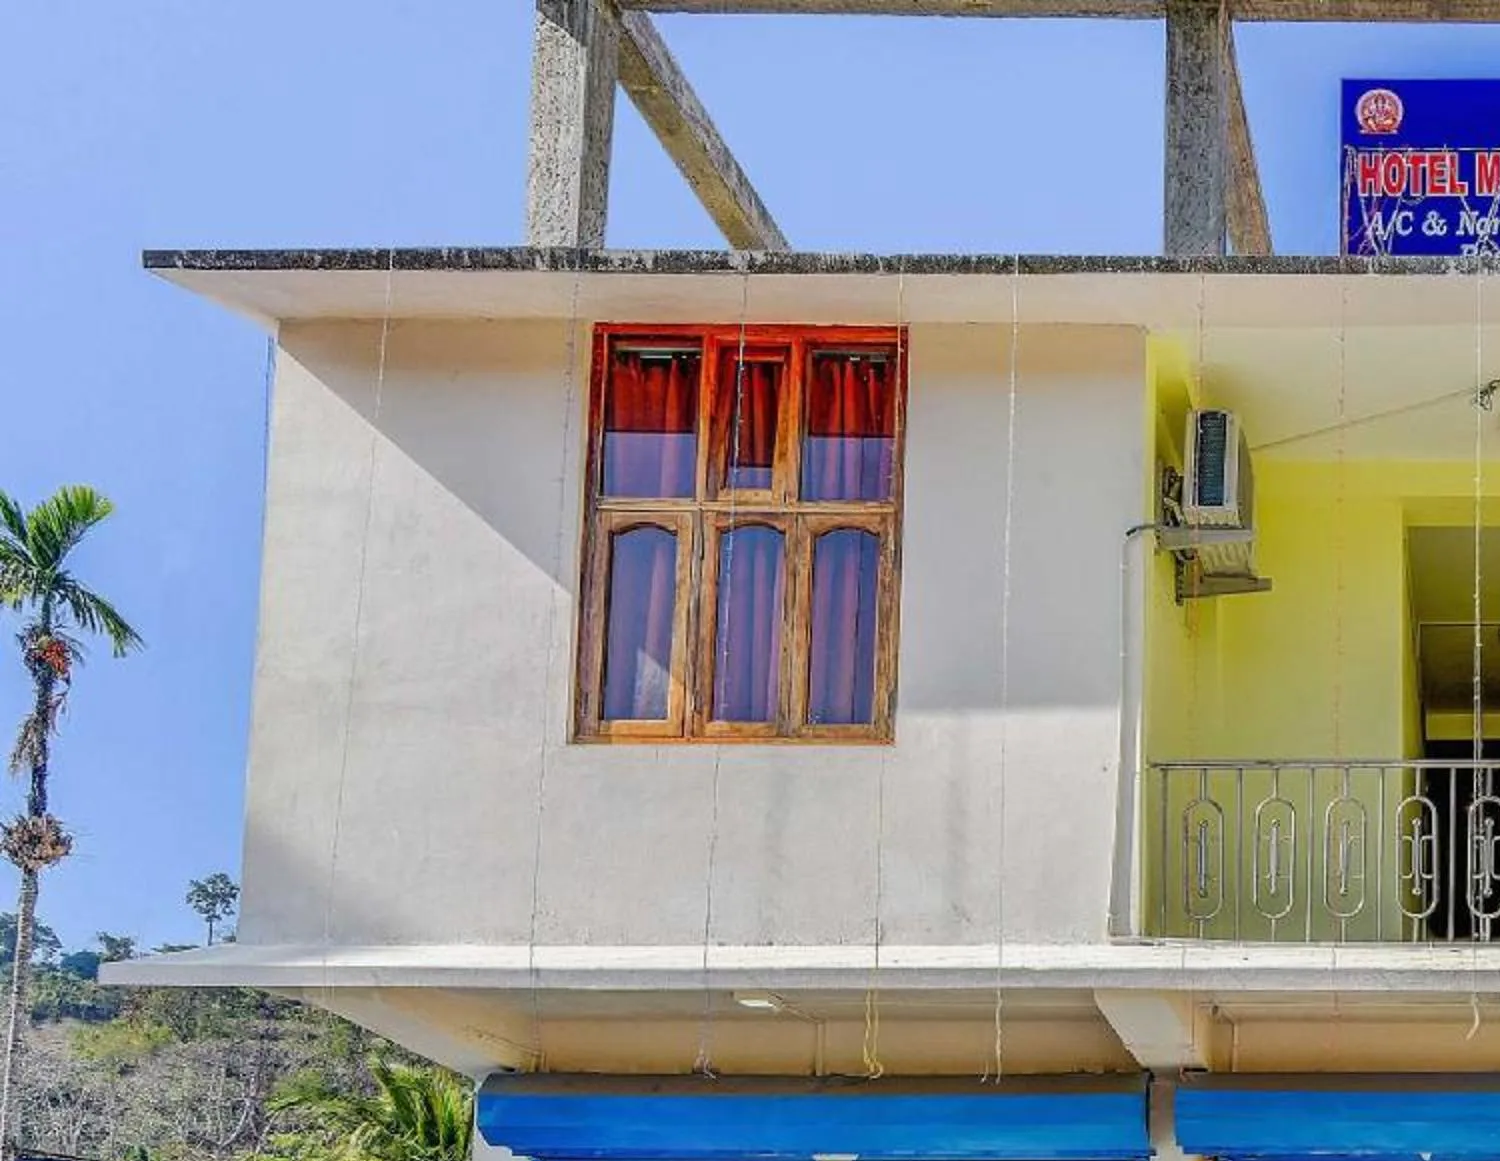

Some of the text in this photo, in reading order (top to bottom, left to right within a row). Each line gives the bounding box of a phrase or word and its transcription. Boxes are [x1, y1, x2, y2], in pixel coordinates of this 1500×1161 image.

[1358, 152, 1467, 197] HOTEL
[1370, 210, 1414, 241] A/C
[1421, 210, 1447, 236] &
